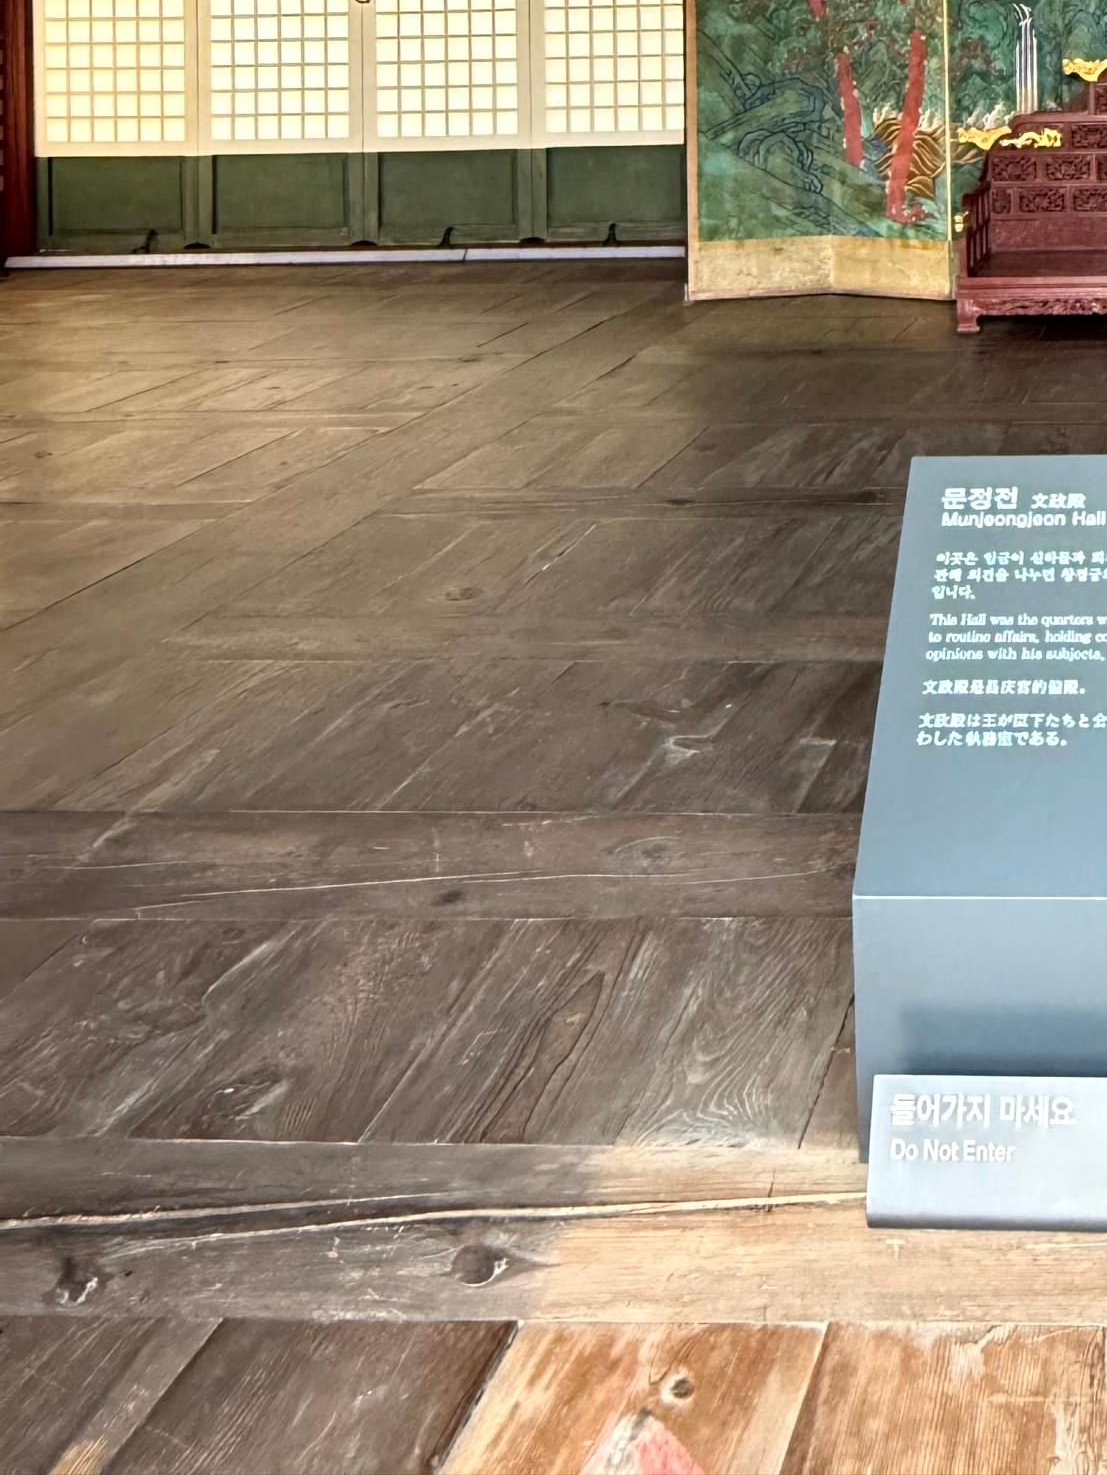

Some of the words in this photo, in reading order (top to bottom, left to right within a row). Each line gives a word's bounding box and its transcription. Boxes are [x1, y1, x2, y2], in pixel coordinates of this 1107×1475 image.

[941, 486, 1019, 511] 문정전
[1030, 492, 1087, 509] 文政殿
[941, 511, 1066, 529] Munjeongjeon
[1071, 510, 1107, 526] Hall
[936, 551, 979, 566] 이곳은
[983, 550, 1025, 566] 임금이
[1030, 550, 1086, 565] 신하들과
[966, 567, 1010, 583] 의견을
[1014, 567, 1055, 582] 나누던
[931, 584, 976, 600] 입니다.
[929, 613, 958, 626] This
[960, 613, 987, 626] Hall
[989, 616, 1014, 626] was
[1017, 612, 1039, 626] the
[1040, 614, 1094, 628] quarters
[928, 631, 943, 643] to
[945, 630, 992, 643] routine
[994, 629, 1040, 644] affairs,
[1044, 629, 1092, 645] holding
[925, 647, 984, 662] opinions
[987, 646, 1017, 660] with
[1021, 647, 1043, 660] his
[1045, 647, 1106, 662] subjects.
[890, 1093, 991, 1129] 들어가지
[999, 1094, 1076, 1129] 마세요
[890, 1138, 919, 1162] Do
[923, 1139, 959, 1162] Not
[963, 1140, 1016, 1163] Enter
